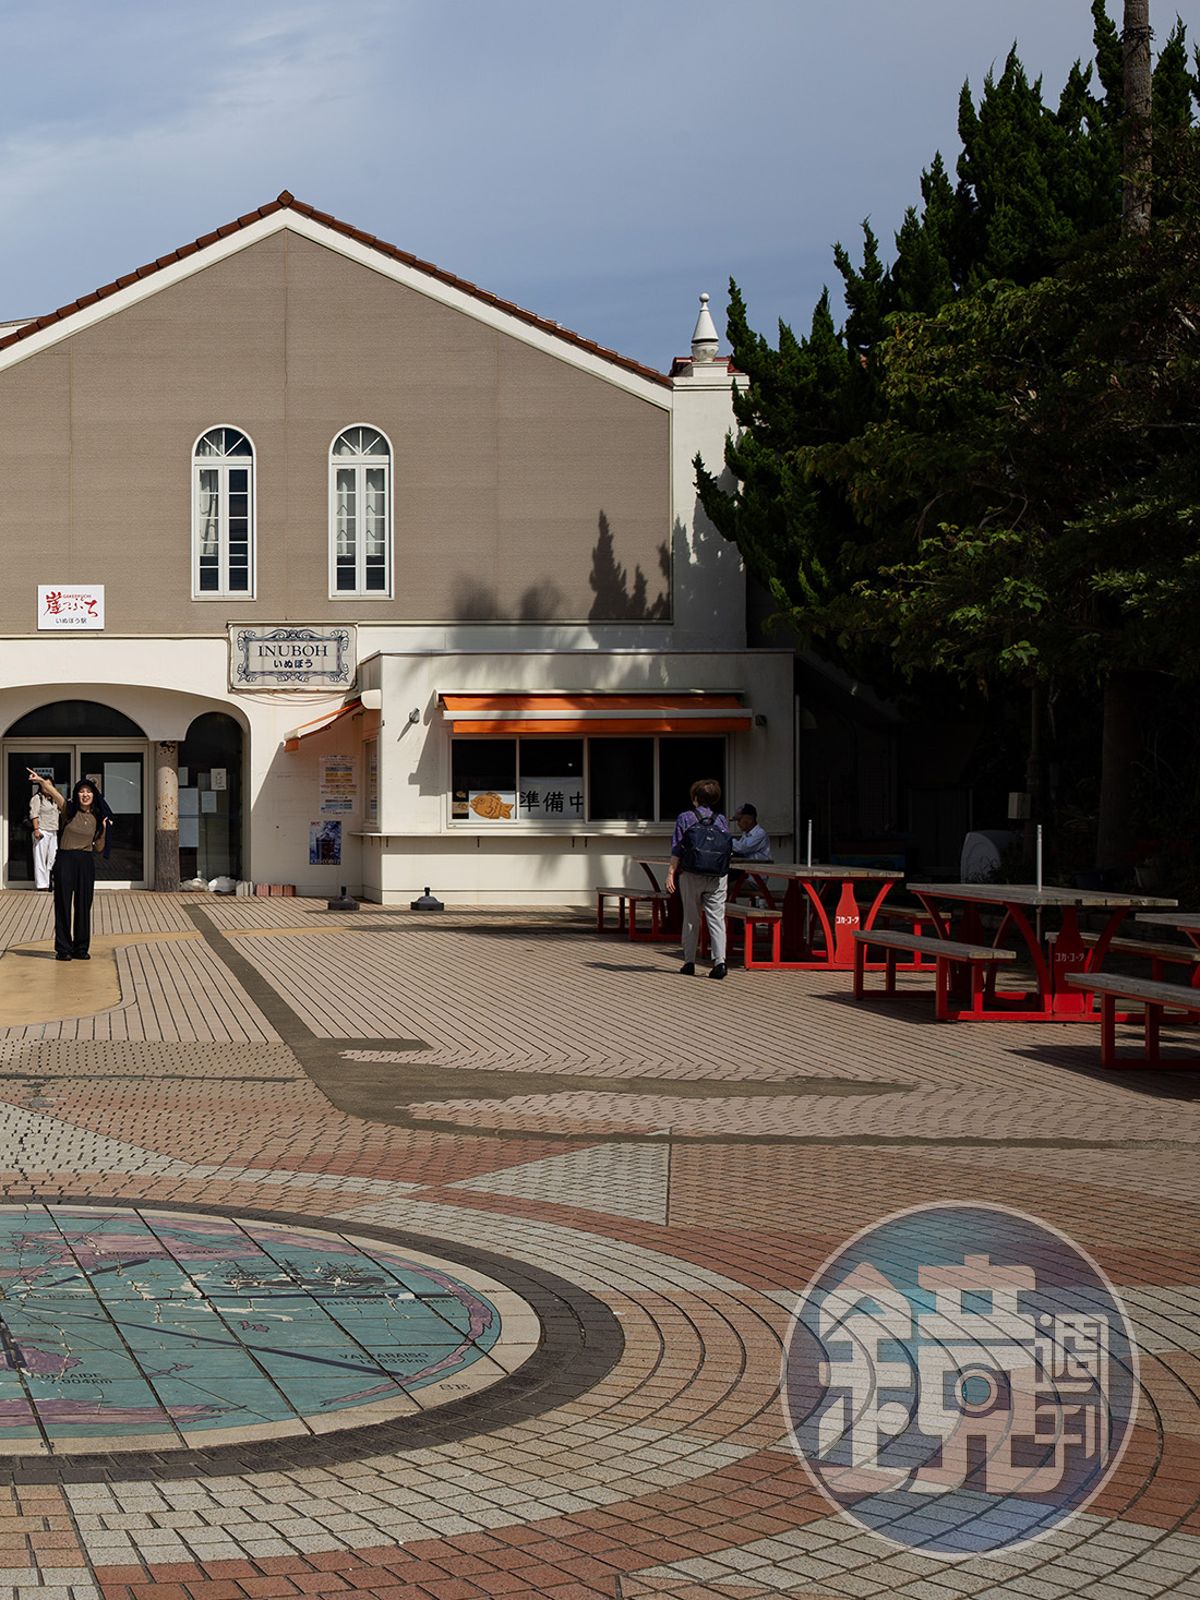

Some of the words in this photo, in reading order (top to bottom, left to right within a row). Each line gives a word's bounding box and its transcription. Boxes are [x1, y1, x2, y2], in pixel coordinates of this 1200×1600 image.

[258, 645, 327, 657] INUBOH
[273, 659, 313, 669] いぬぼう
[519, 791, 584, 812] 準備中
